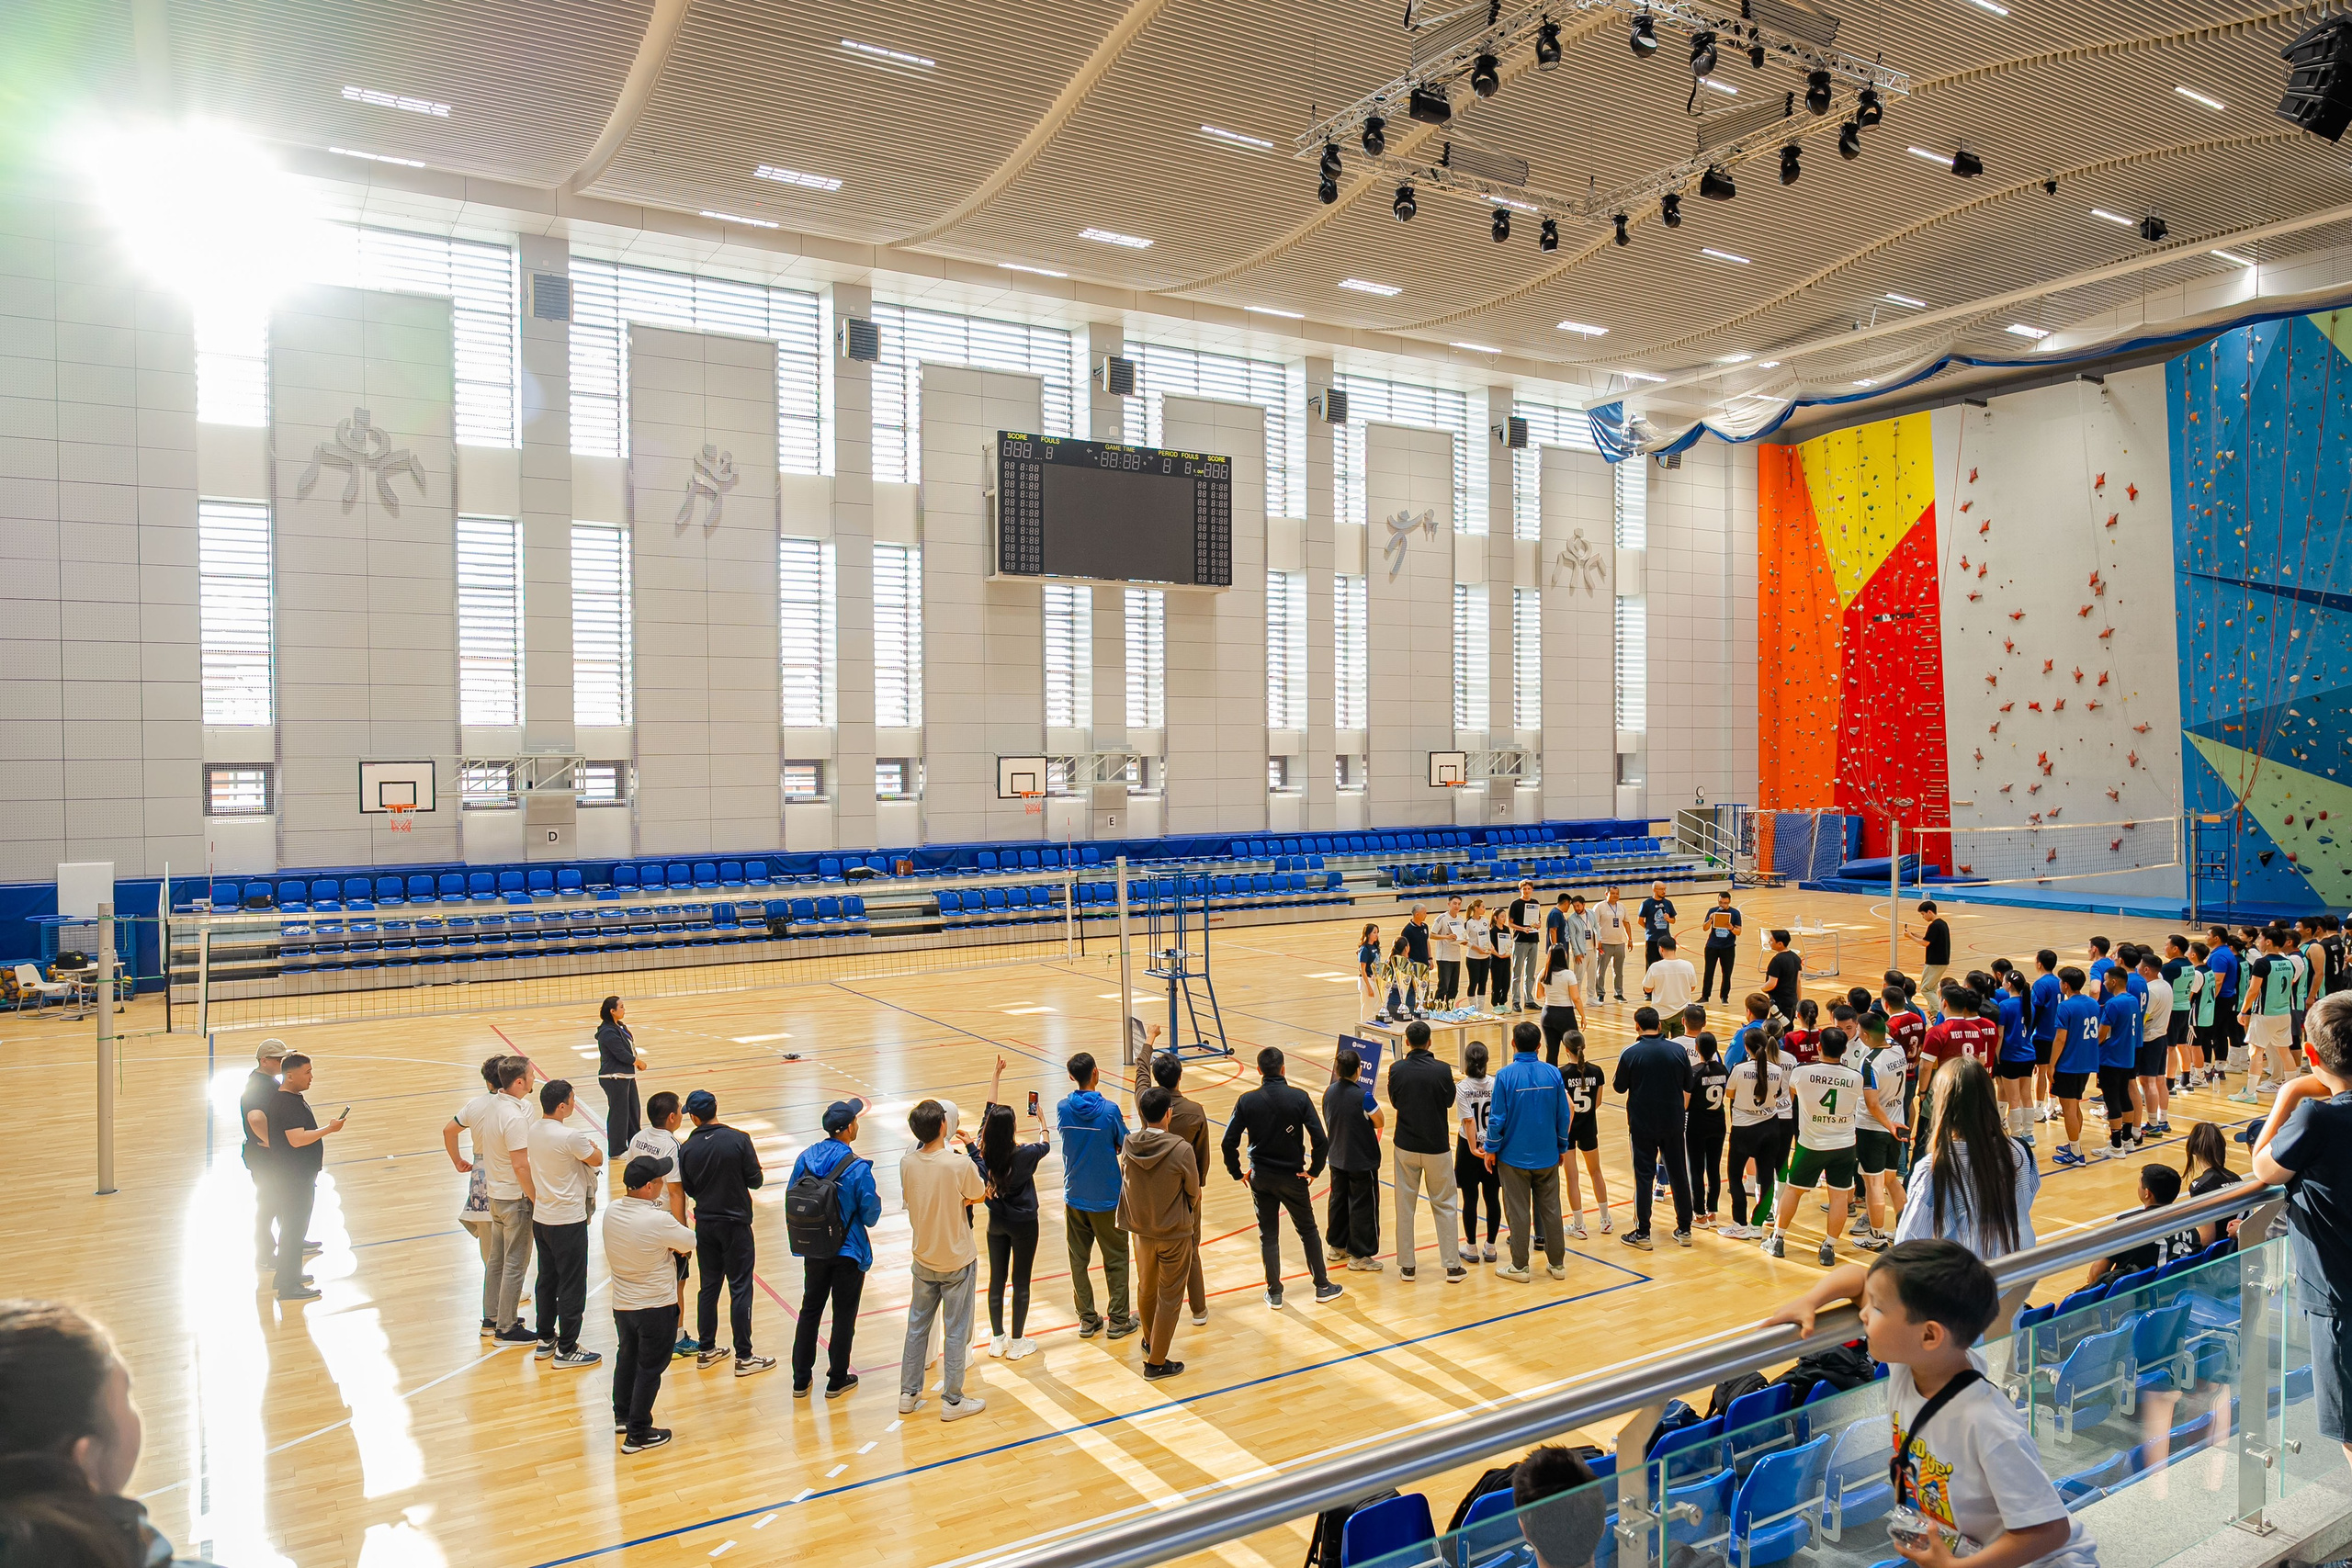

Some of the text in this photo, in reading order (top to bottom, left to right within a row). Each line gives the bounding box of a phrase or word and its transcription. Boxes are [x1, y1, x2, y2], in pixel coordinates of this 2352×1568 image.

[1041, 436, 1060, 445] FOULS
[1109, 817, 1114, 826] E
[548, 831, 558, 841] D
[2280, 976, 2288, 994] 9
[1900, 1025, 1911, 1035] WEST
[2083, 1015, 2098, 1040] 23
[1950, 1031, 1963, 1040] WEST
[1567, 1077, 1597, 1089] ASSAOVA
[1810, 1074, 1855, 1088] ORAZGALI
[1895, 1070, 1904, 1097] 7
[1573, 1086, 1592, 1113] 5
[1705, 1084, 1724, 1110] 9
[1819, 1089, 1838, 1115] 4
[1471, 1101, 1491, 1132] 16
[1812, 1114, 1837, 1123] BATYS
